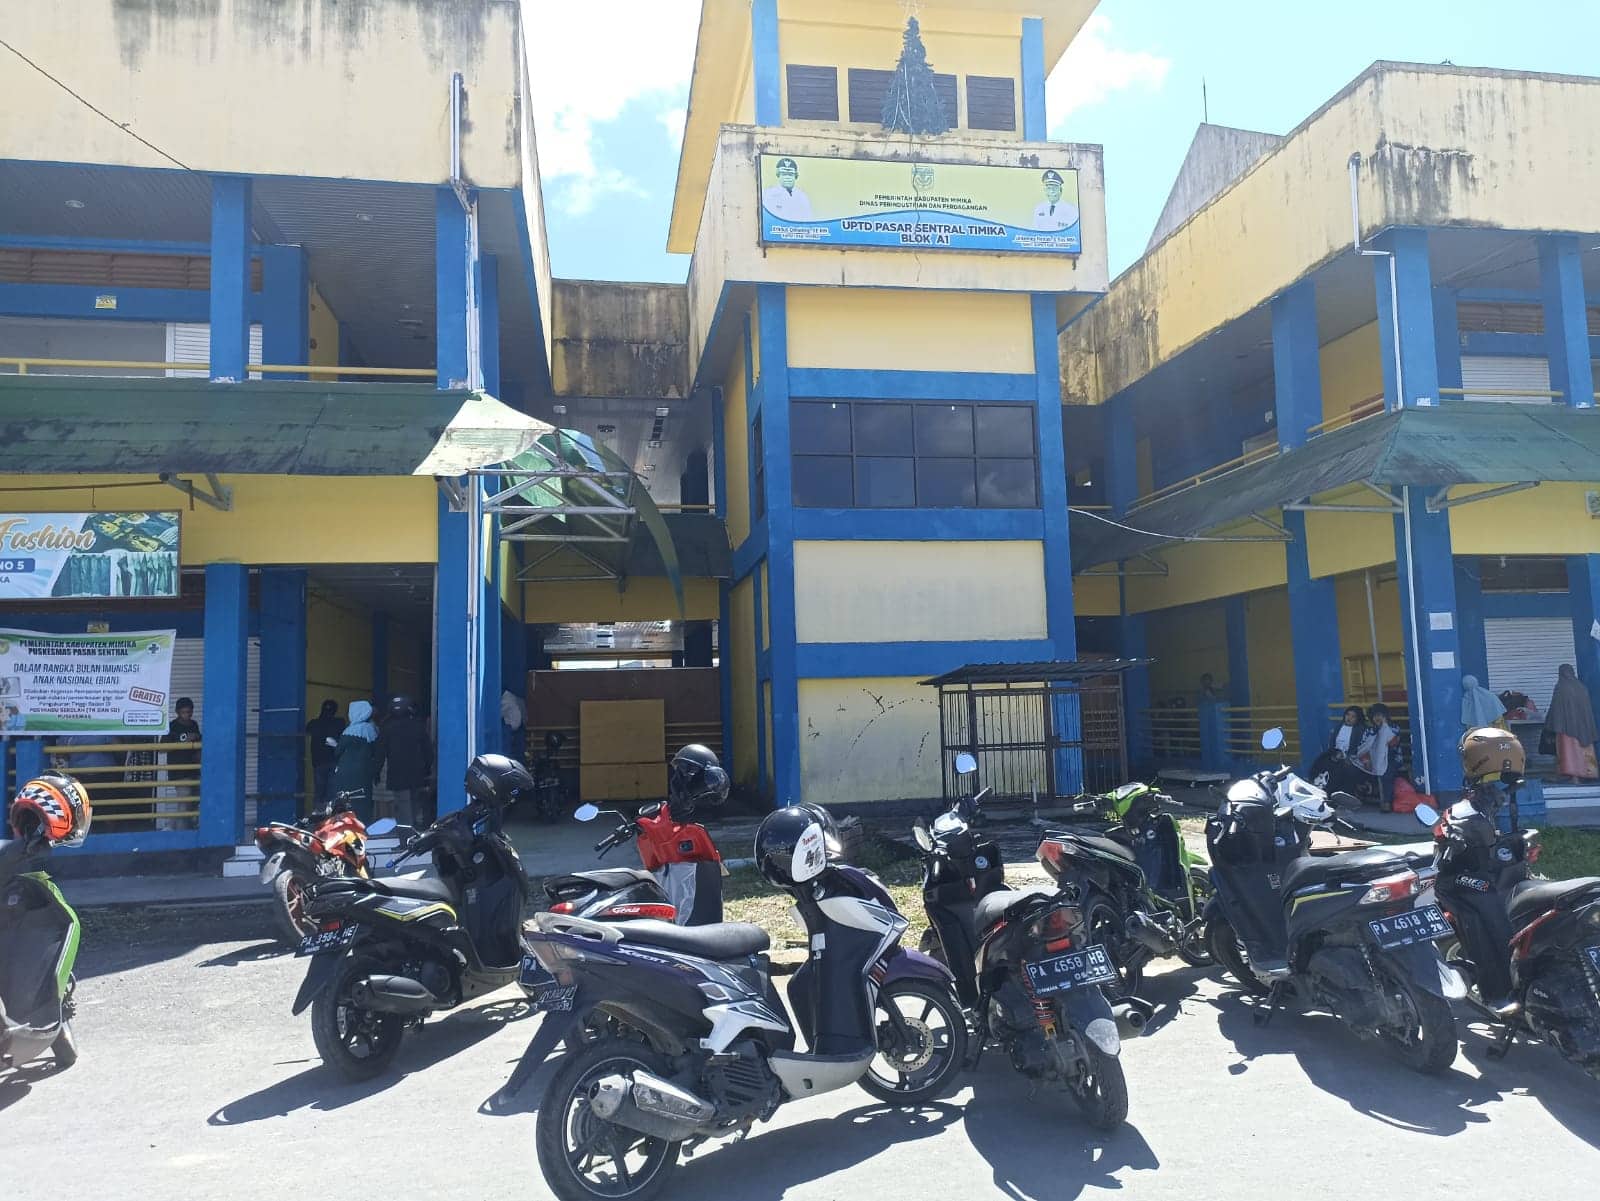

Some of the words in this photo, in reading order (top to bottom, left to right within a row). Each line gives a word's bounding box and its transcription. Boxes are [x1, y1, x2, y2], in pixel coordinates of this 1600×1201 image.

[914, 195, 950, 203] KABUPATEN
[880, 201, 928, 209] PERINDUSTRIAN
[842, 221, 873, 231] UPTD
[876, 222, 912, 233] PASAR
[915, 223, 966, 234] SENTRAL
[968, 225, 1006, 236] TIMIKA
[901, 234, 931, 244] BLOK
[936, 235, 950, 244] A1
[0, 518, 95, 550] Fashion
[17, 561, 25, 570] 5
[19, 640, 65, 648] PEMERINTAH
[109, 640, 137, 648] MIMIKA
[28, 648, 71, 656] PUSKESMAS
[73, 648, 97, 656] PASAR
[98, 648, 129, 656] SENTRAL
[13, 663, 42, 673] DALAM
[43, 663, 74, 673] RANGKA
[76, 664, 101, 674] BULAN
[102, 664, 140, 673] IMUNISASI
[33, 675, 54, 684] ANAK
[56, 675, 93, 685] NASIONAL
[132, 689, 162, 703] GRATIS
[1372, 923, 1389, 935] PA
[1394, 914, 1421, 930] 4618
[1423, 909, 1440, 922] HE
[1029, 965, 1047, 979] PA
[1054, 956, 1083, 973] 4658
[1088, 950, 1105, 965] HB
